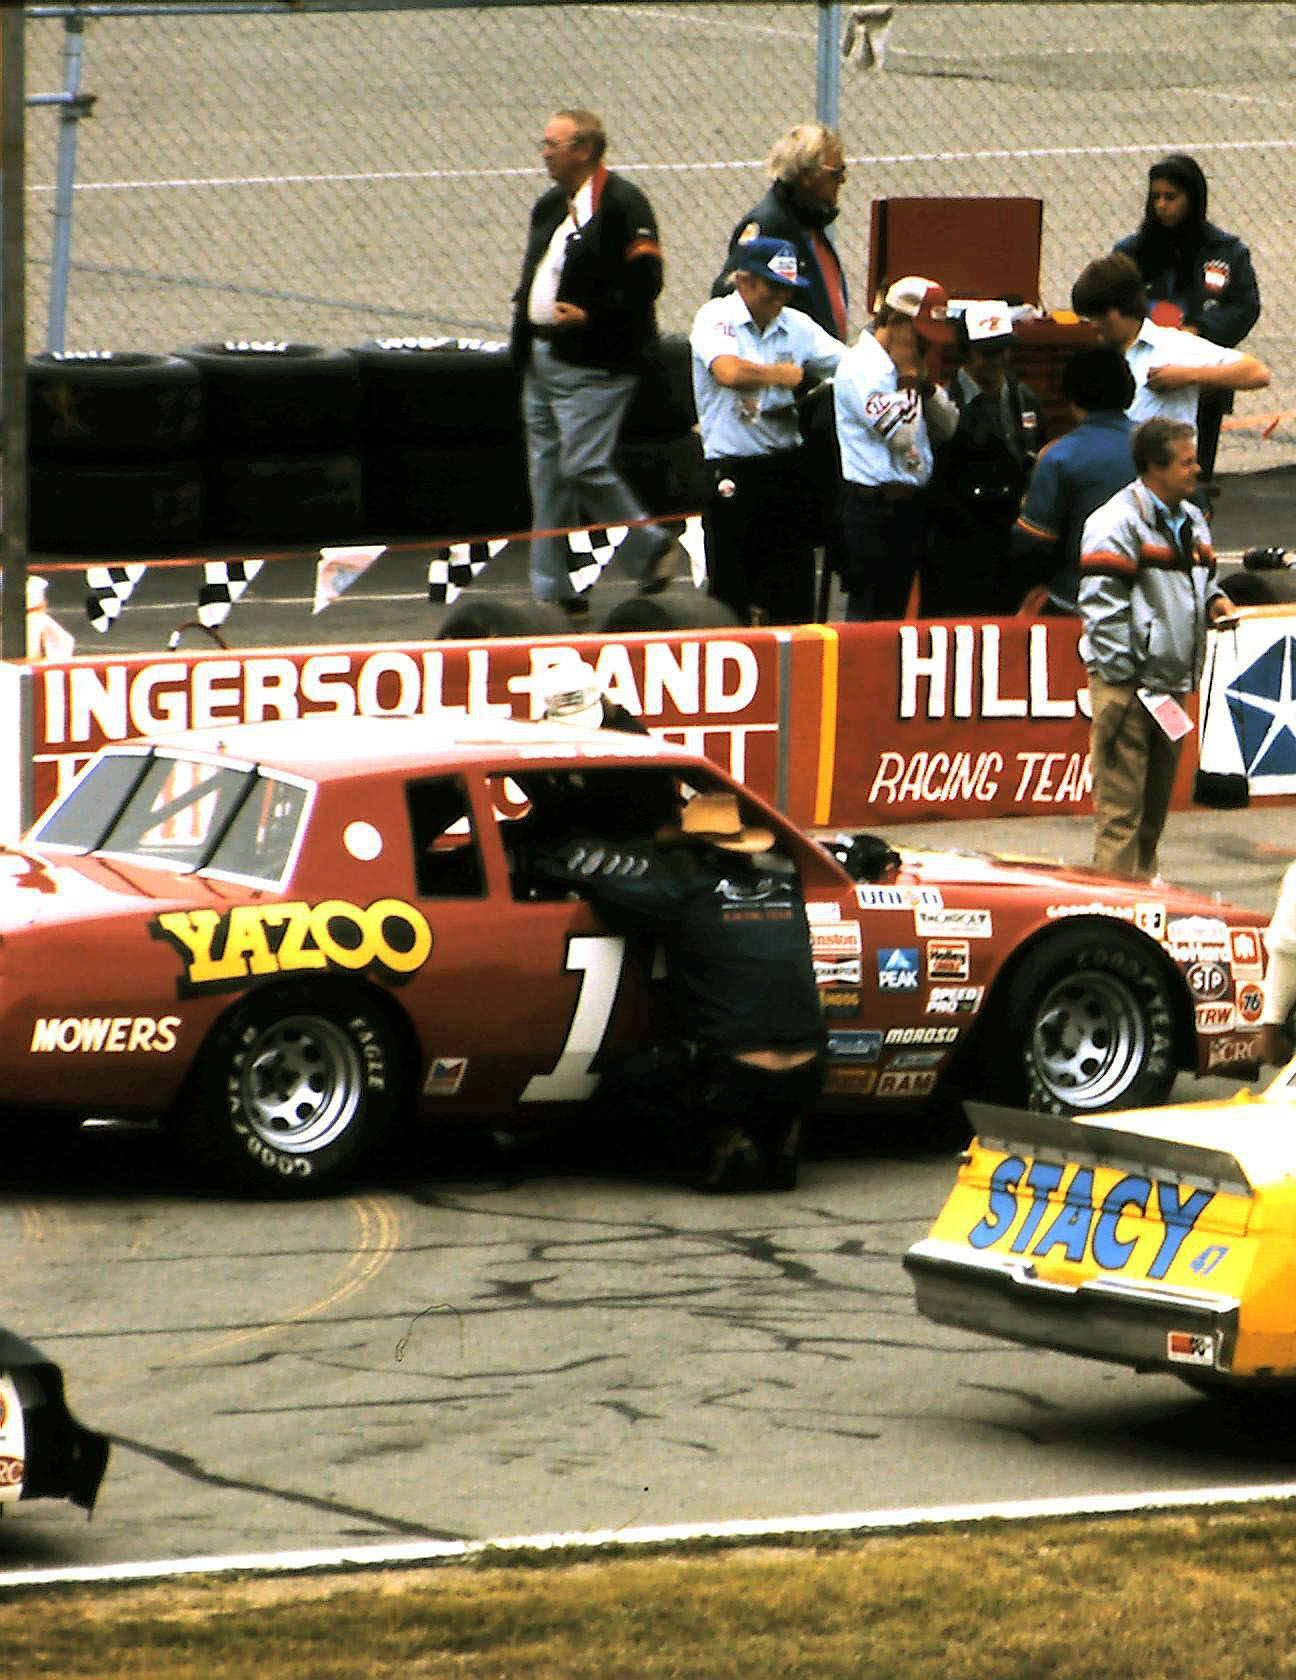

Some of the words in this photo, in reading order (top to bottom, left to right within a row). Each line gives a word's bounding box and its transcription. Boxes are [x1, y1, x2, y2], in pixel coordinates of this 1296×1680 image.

[900, 624, 1093, 719] HILL
[868, 752, 1003, 804] RACING
[157, 898, 433, 984] YAZOO
[878, 970, 919, 989] PEAK
[1192, 965, 1223, 992] STP
[1197, 1007, 1233, 1024] TRW
[31, 1017, 181, 1053] MOWERS
[882, 1071, 932, 1090] RAM
[968, 1155, 1216, 1280] STACY
